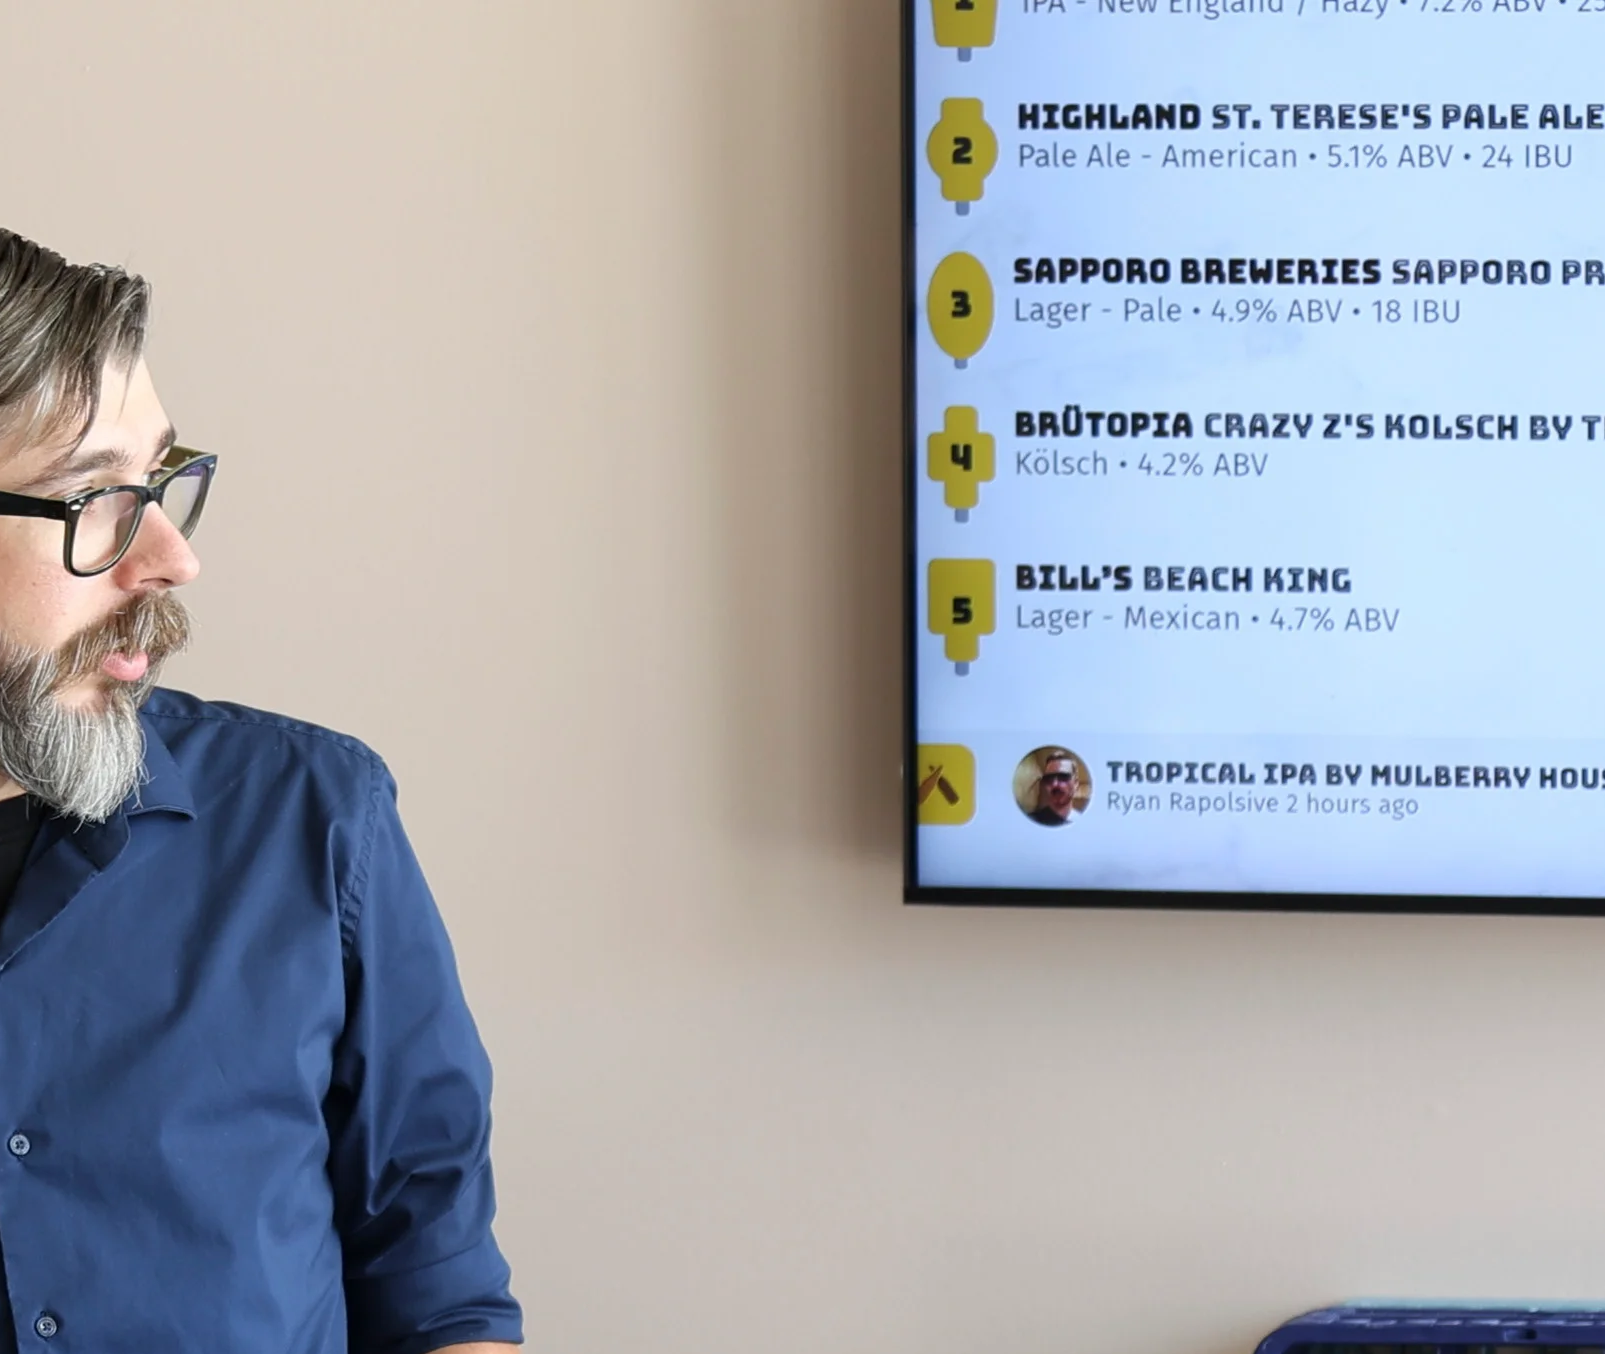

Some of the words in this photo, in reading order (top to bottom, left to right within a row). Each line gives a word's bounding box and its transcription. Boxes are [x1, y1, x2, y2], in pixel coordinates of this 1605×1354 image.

[1017, 103, 1201, 130] HIGHLAND
[1211, 103, 1261, 130] ST.
[1269, 103, 1432, 130] TERESE'S
[1441, 103, 1529, 130] PALE
[1538, 103, 1605, 130] ALE
[951, 136, 973, 165] 2
[1018, 142, 1077, 168] Pale
[1086, 142, 1131, 168] Ale
[1161, 142, 1297, 169] American
[1327, 143, 1388, 169] 5.1%
[1397, 144, 1454, 169] ABV
[1481, 144, 1514, 169] 24
[1525, 144, 1572, 169] IBU
[1013, 257, 1171, 285] SAPPORO
[1180, 257, 1382, 285] BREWERIES
[1392, 259, 1552, 286] SAPPORO
[950, 289, 972, 319] 3
[1014, 297, 1092, 330] Lager
[1123, 296, 1182, 323] Pale
[1211, 298, 1278, 324] 4.9%
[1286, 298, 1343, 324] ABV
[1371, 299, 1402, 324] 18
[1413, 299, 1460, 324] IBU
[1014, 404, 1193, 439] BRÜTOPIA
[1204, 412, 1314, 439] CRAZY
[1322, 413, 1375, 439] Z'S
[1384, 413, 1519, 441] KOLSCH
[1529, 414, 1573, 441] BY
[1581, 415, 1605, 441] T
[950, 443, 973, 472] 4
[1015, 448, 1108, 476] Kölsch
[1137, 451, 1204, 477] 4.2%
[1213, 452, 1269, 477] ABV
[1015, 563, 1133, 592] BILL'S
[1143, 565, 1253, 593] BEACH
[1263, 567, 1352, 593] KING
[951, 595, 973, 625] 5
[1016, 603, 1093, 636] Lager
[1123, 603, 1240, 631] Mexican
[1269, 606, 1335, 632] 4.7%
[1344, 607, 1400, 633] ABV
[1106, 760, 1256, 785] TROPICAL
[1263, 762, 1317, 786] IPA
[1325, 763, 1363, 787] BY
[1370, 764, 1531, 789] MULBERRY
[1539, 767, 1605, 790] HOU
[1107, 790, 1161, 816] Ryan
[1169, 790, 1279, 817] Rapolsive
[1286, 793, 1298, 814] 2
[1306, 791, 1371, 815] hours
[1380, 797, 1419, 821] ago
